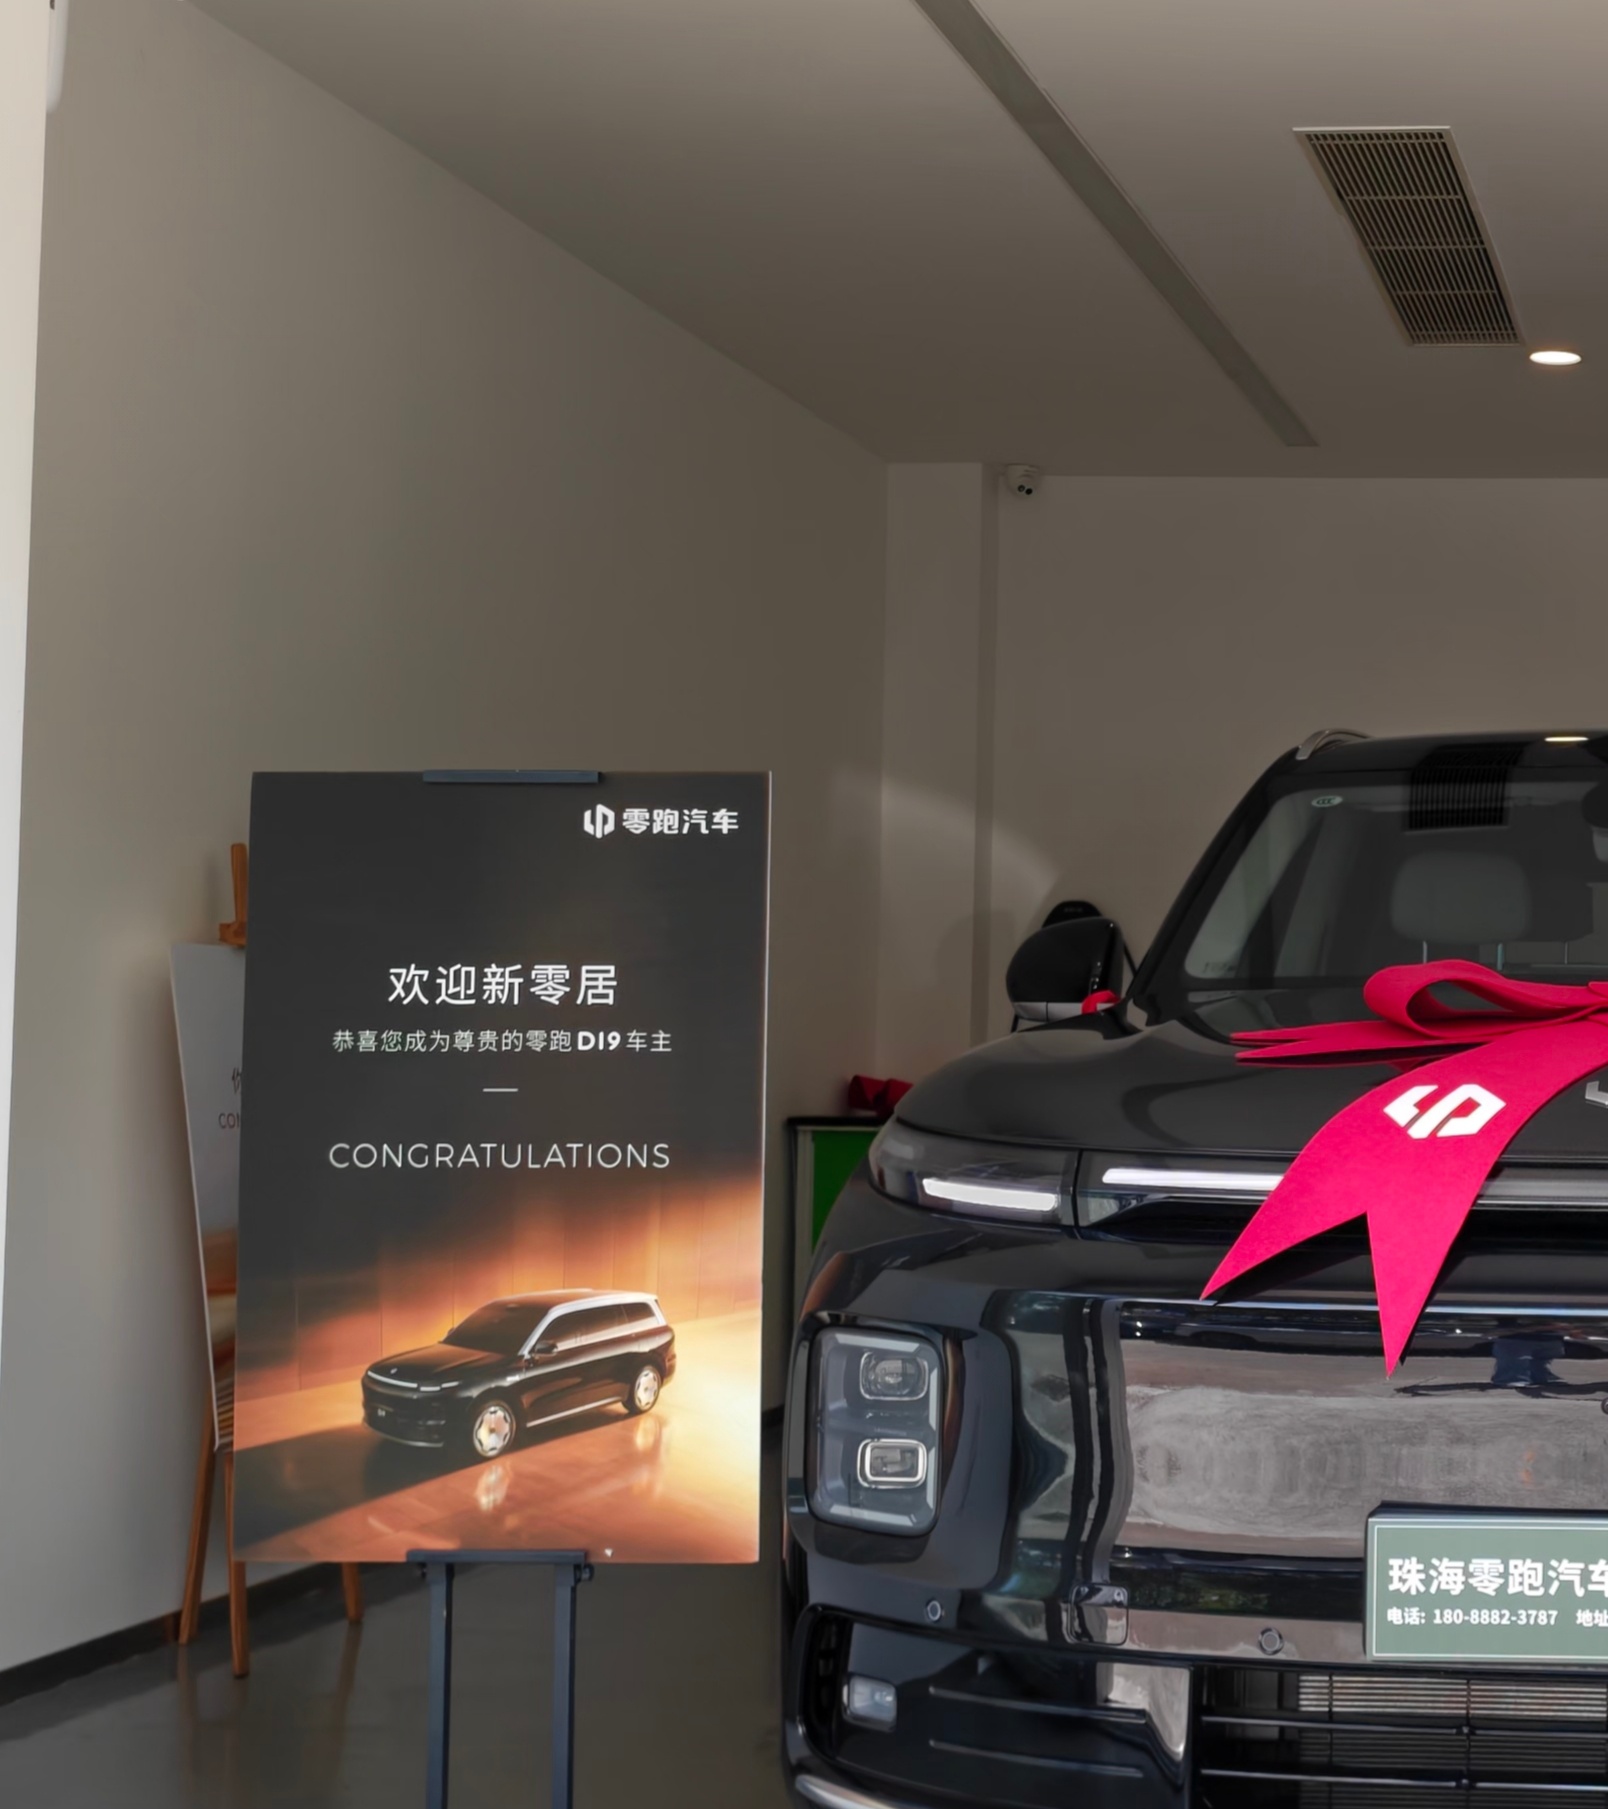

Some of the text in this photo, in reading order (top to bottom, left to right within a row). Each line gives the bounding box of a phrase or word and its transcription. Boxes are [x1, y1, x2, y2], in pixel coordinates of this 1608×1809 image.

[621, 807, 739, 835] 零跑汽车
[387, 962, 618, 1007] 欢迎新零居
[328, 1142, 670, 1169] CONGRATULATIONS
